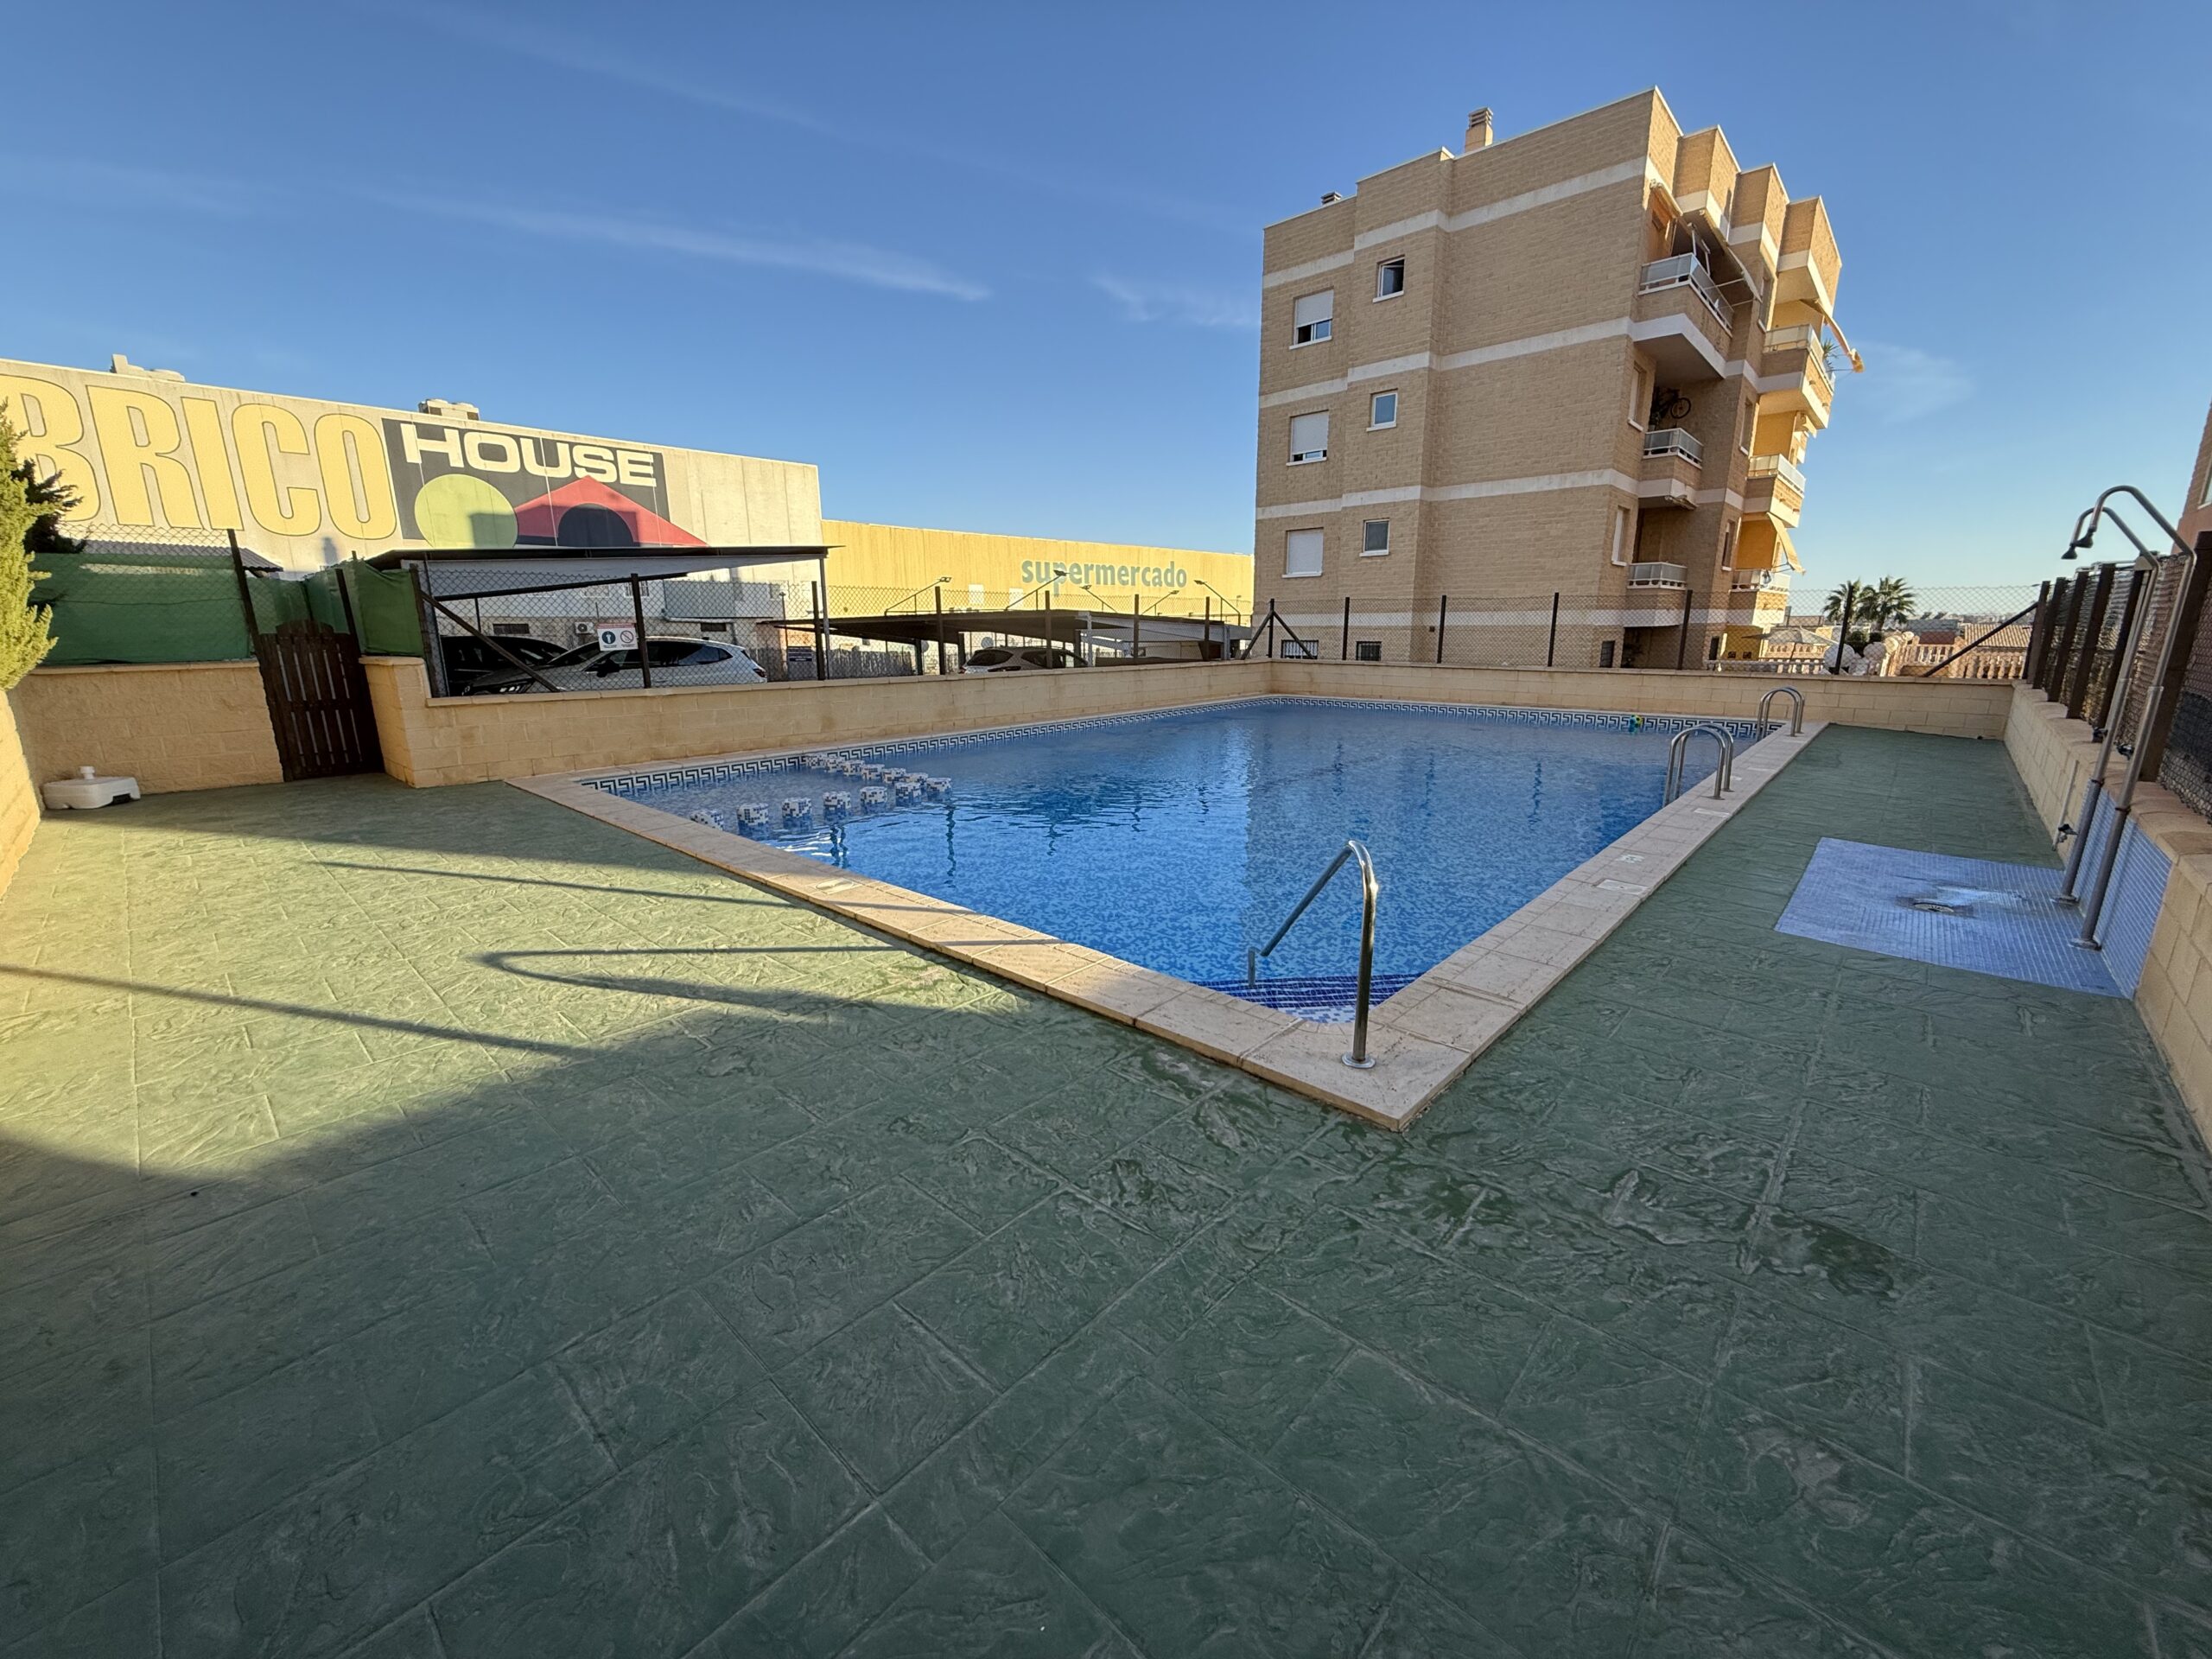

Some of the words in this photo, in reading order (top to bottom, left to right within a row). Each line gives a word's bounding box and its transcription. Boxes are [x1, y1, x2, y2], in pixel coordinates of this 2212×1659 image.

[0, 374, 397, 540] BRICO
[400, 423, 657, 487] HOUSE
[1021, 559, 1187, 598] supermercado
